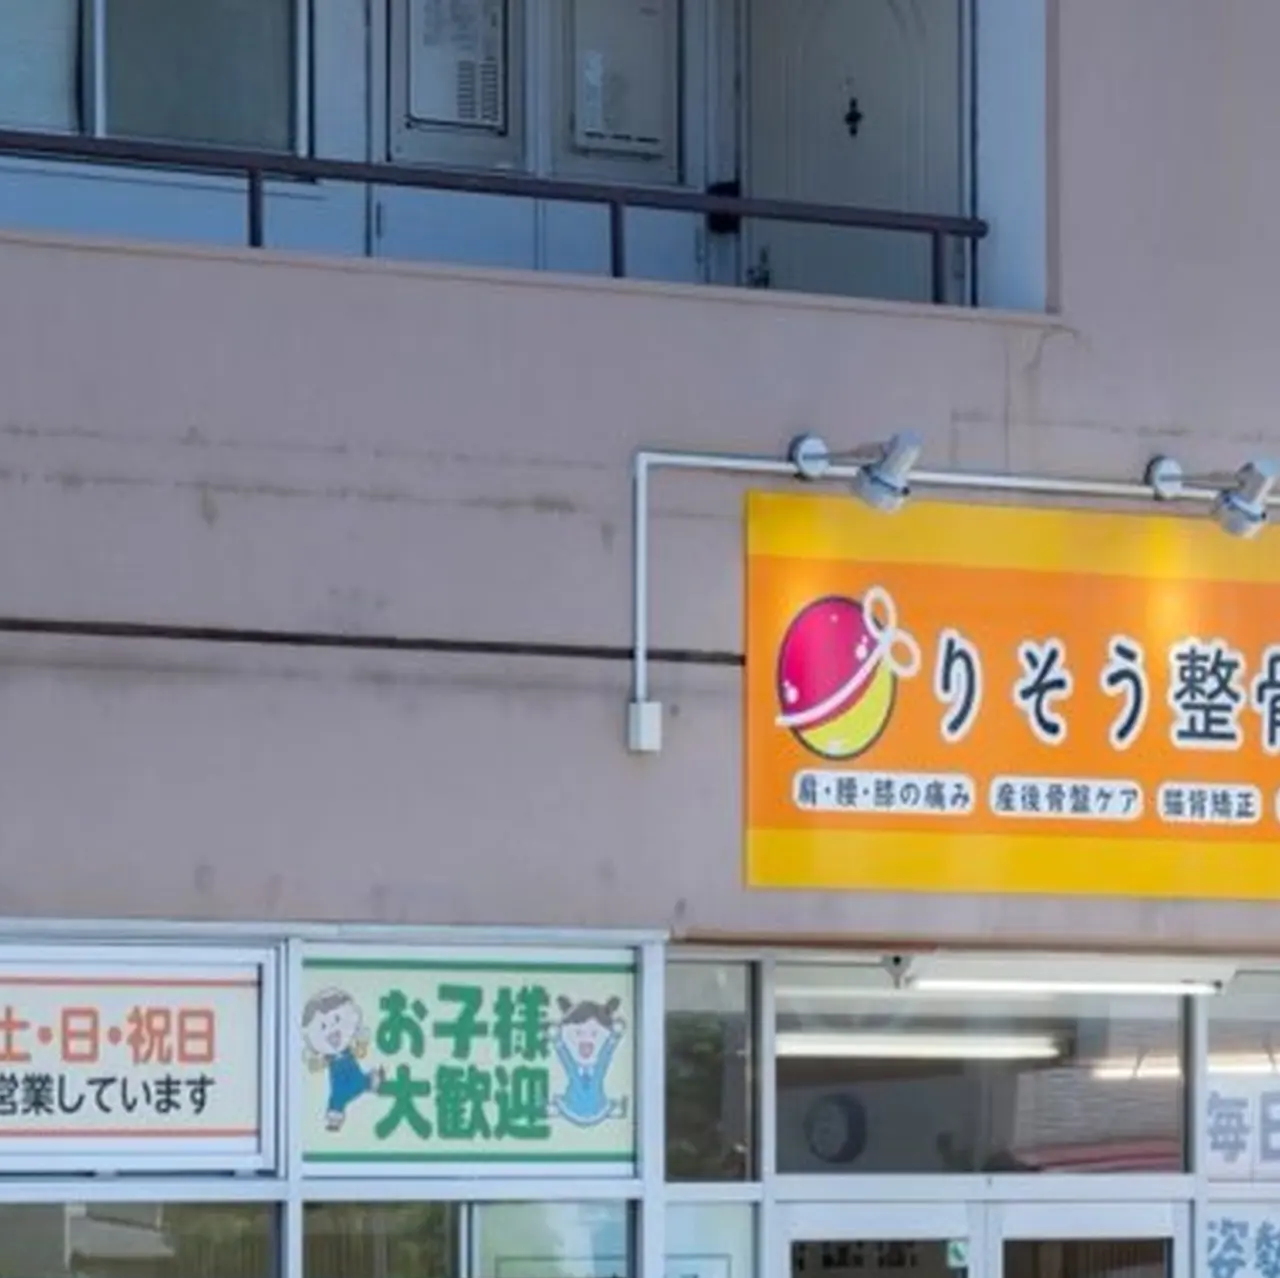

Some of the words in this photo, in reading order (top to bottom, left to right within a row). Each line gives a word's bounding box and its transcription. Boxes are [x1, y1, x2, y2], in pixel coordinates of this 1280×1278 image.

[996, 782, 1138, 814] 産後骨盤ケア
[1164, 788, 1255, 819] 猫背矯正
[376, 985, 551, 1062] お子様
[376, 1066, 550, 1141] 大歓迎
